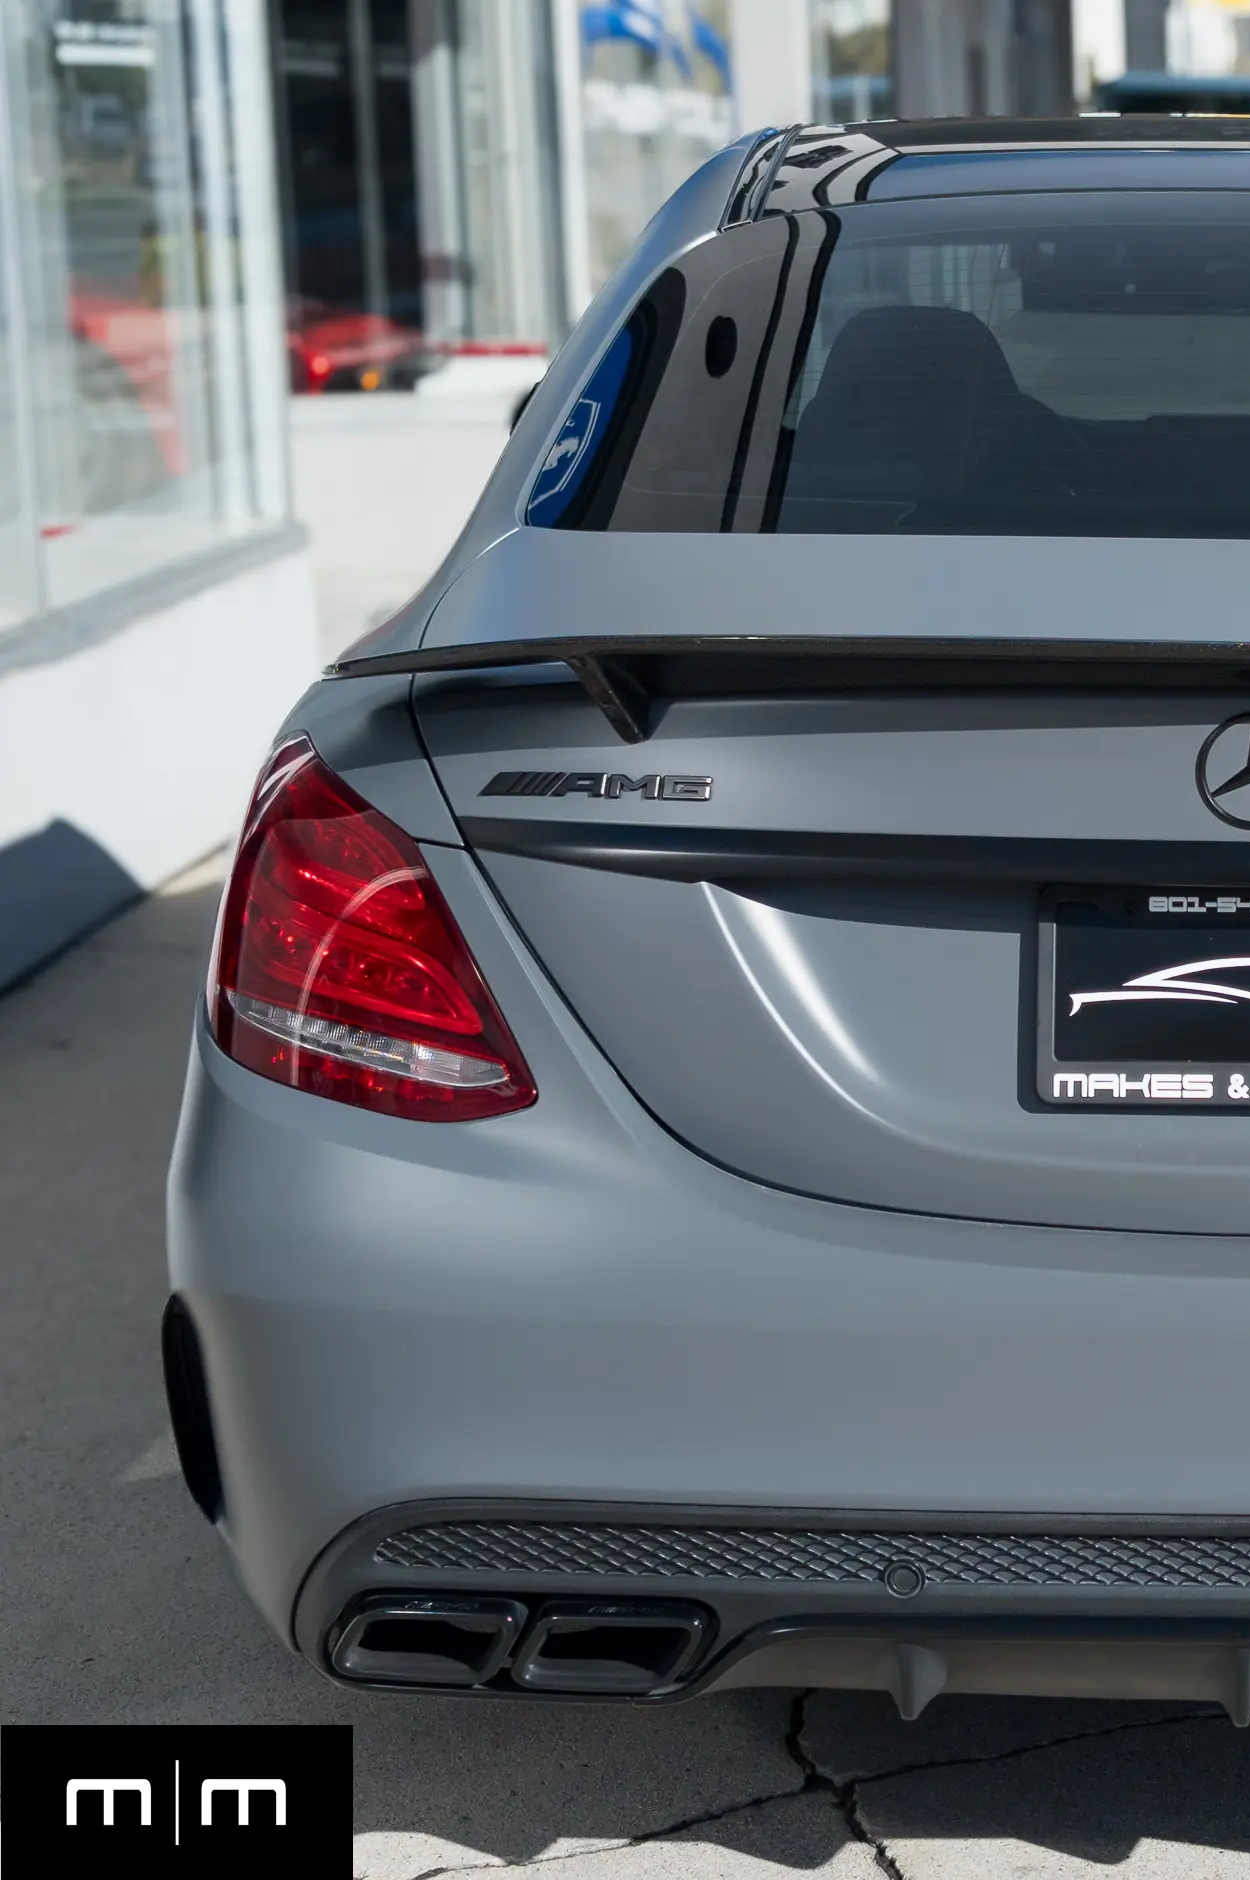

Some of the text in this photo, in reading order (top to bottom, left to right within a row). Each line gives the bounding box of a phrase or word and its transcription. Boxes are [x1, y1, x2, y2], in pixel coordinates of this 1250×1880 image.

[549, 772, 714, 801] AMG
[1053, 1073, 1214, 1099] MAKES
[1227, 1073, 1250, 1099] &
